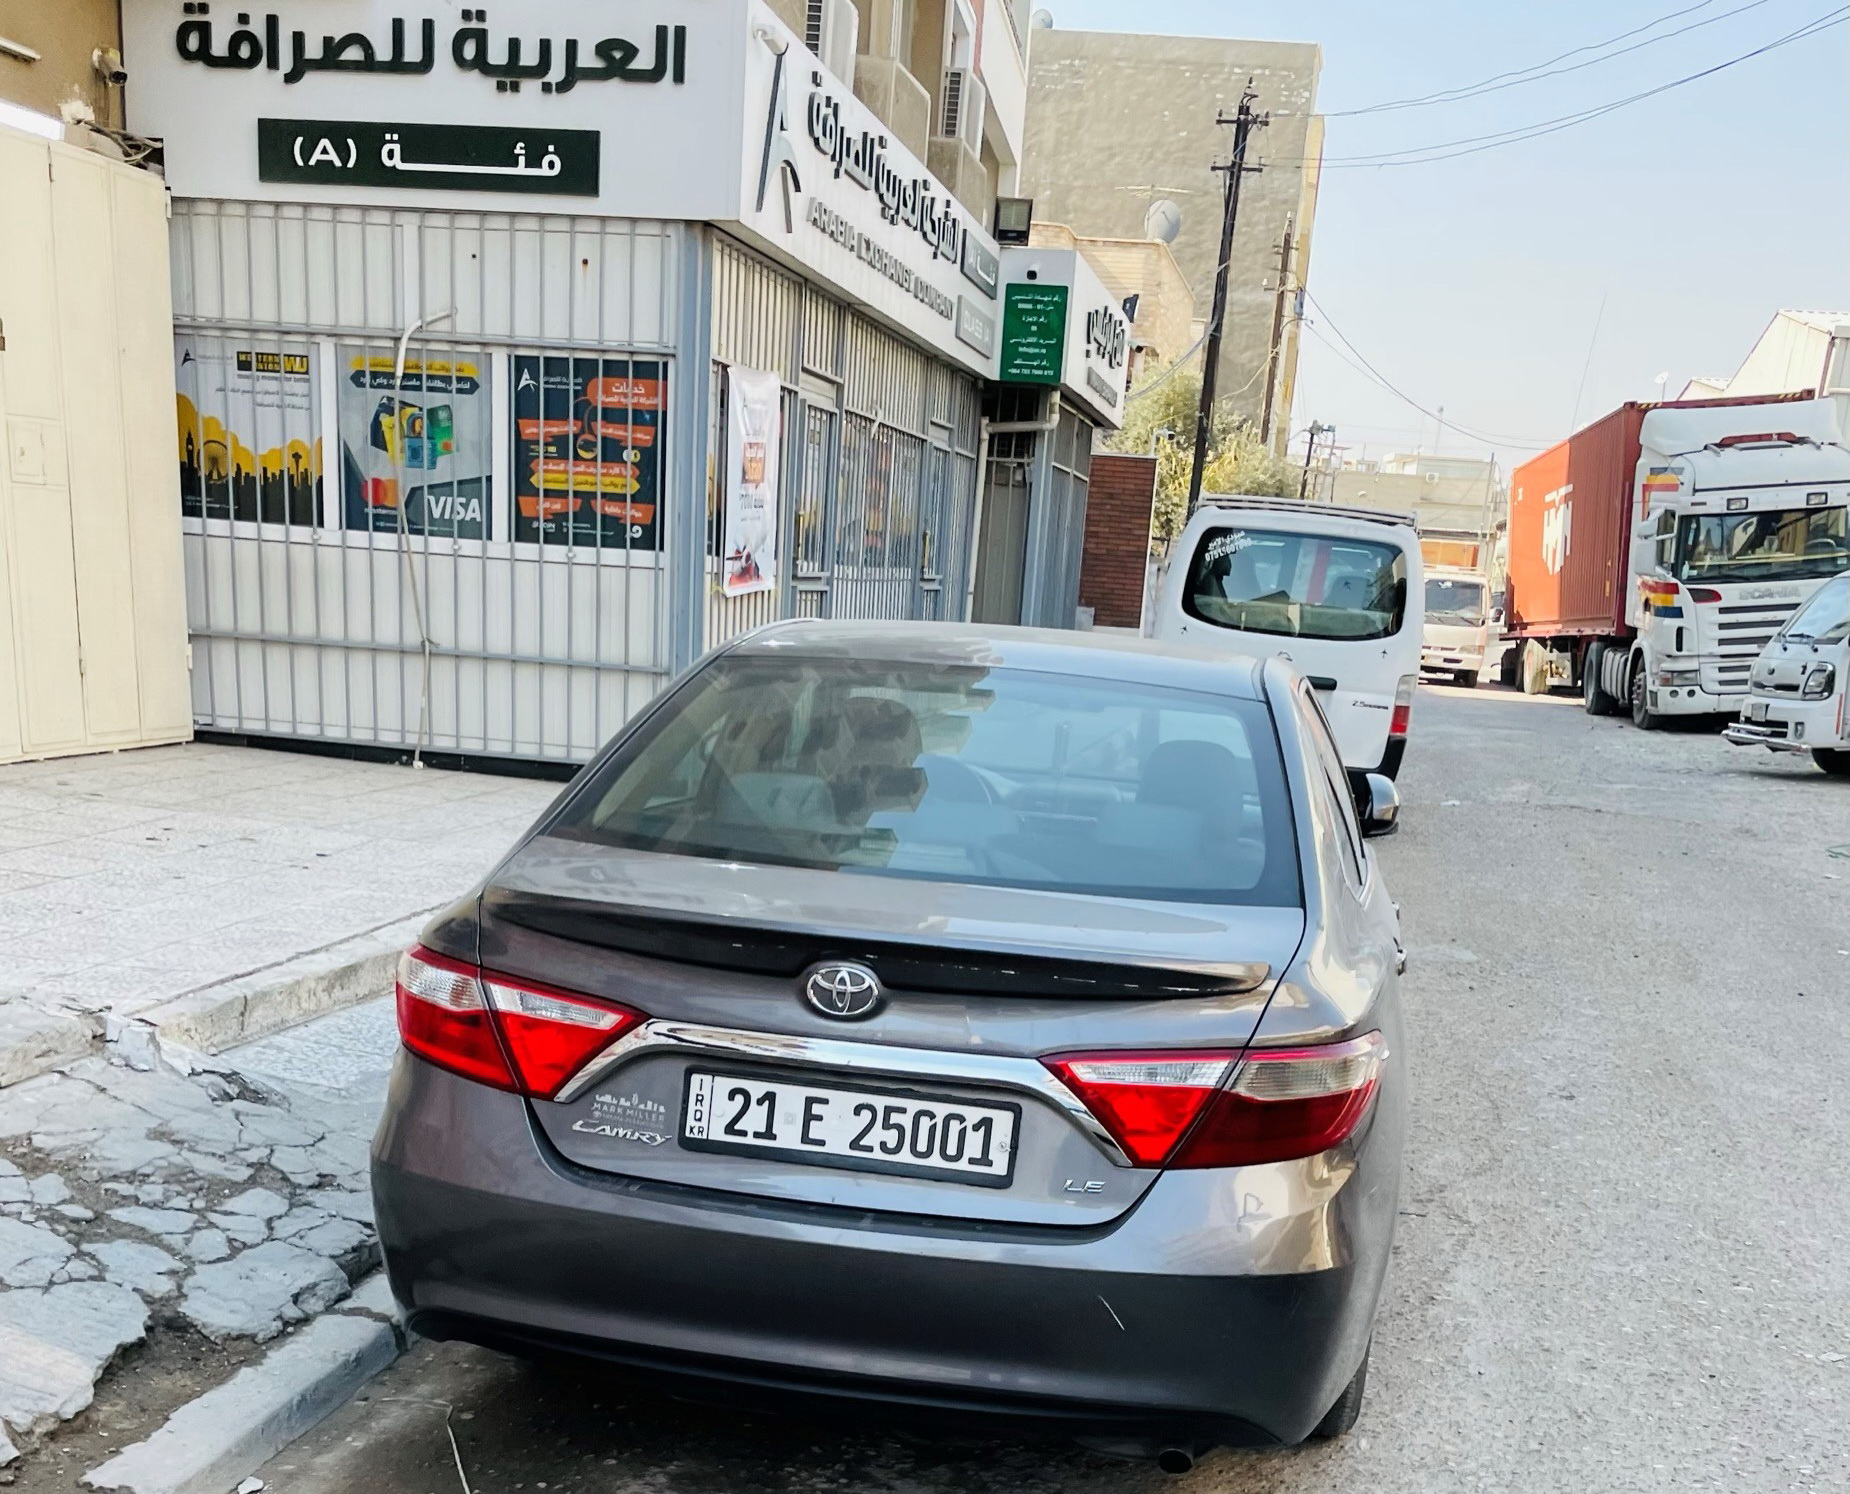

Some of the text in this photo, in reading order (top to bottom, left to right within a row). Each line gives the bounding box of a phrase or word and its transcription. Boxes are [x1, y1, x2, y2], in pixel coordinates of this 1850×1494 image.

[175, 2, 687, 94] العربية للصرافة
[293, 137, 358, 168] (A)
[806, 197, 856, 253] ARABIA
[239, 353, 281, 362] WETERN
[612, 381, 645, 393] خدات
[426, 495, 481, 522] VISA
[591, 1102, 624, 1115] MARK
[625, 1108, 665, 1122] MILLER
[572, 1119, 673, 1146] CAMRY
[689, 1124, 705, 1137] KR
[723, 1086, 994, 1168] 21 E 25001
[1063, 1179, 1106, 1194] LE
